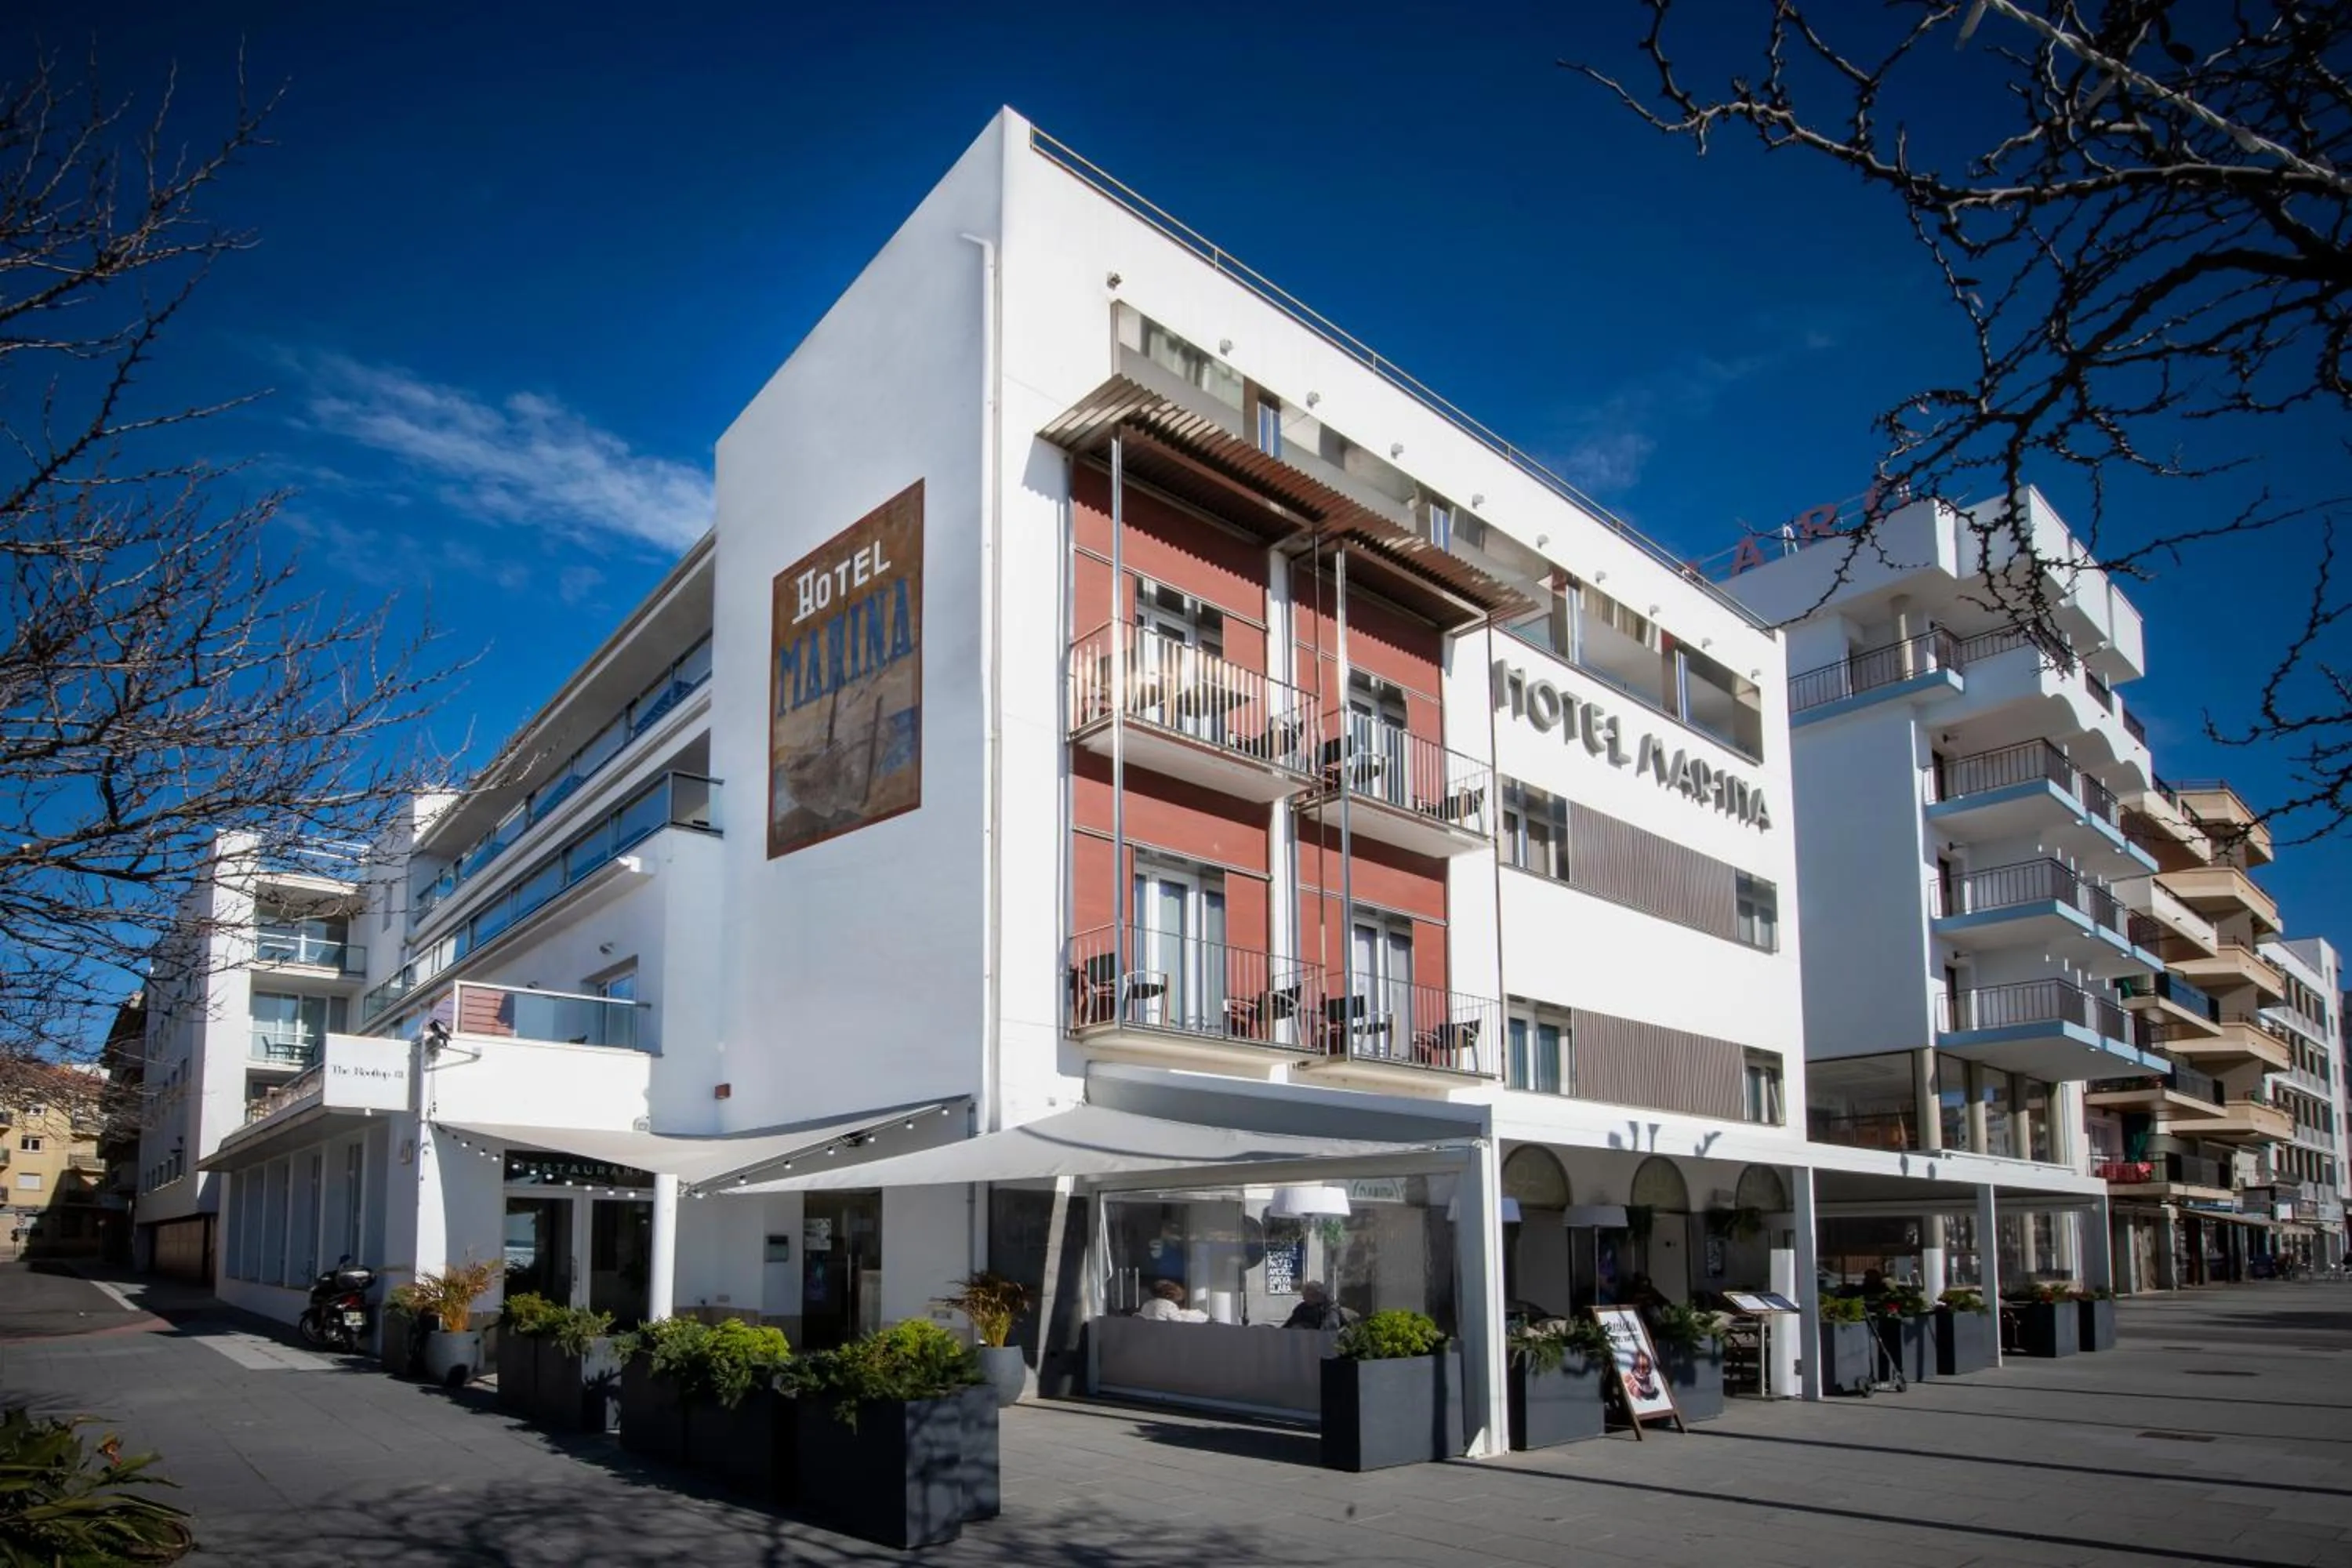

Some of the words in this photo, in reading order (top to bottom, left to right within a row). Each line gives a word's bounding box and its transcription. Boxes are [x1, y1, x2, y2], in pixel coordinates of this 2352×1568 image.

[777, 578, 913, 718] MARINA
[793, 539, 891, 626] HOTEL
[1494, 659, 1631, 770] HOTEL
[1636, 733, 1773, 834] MARINA
